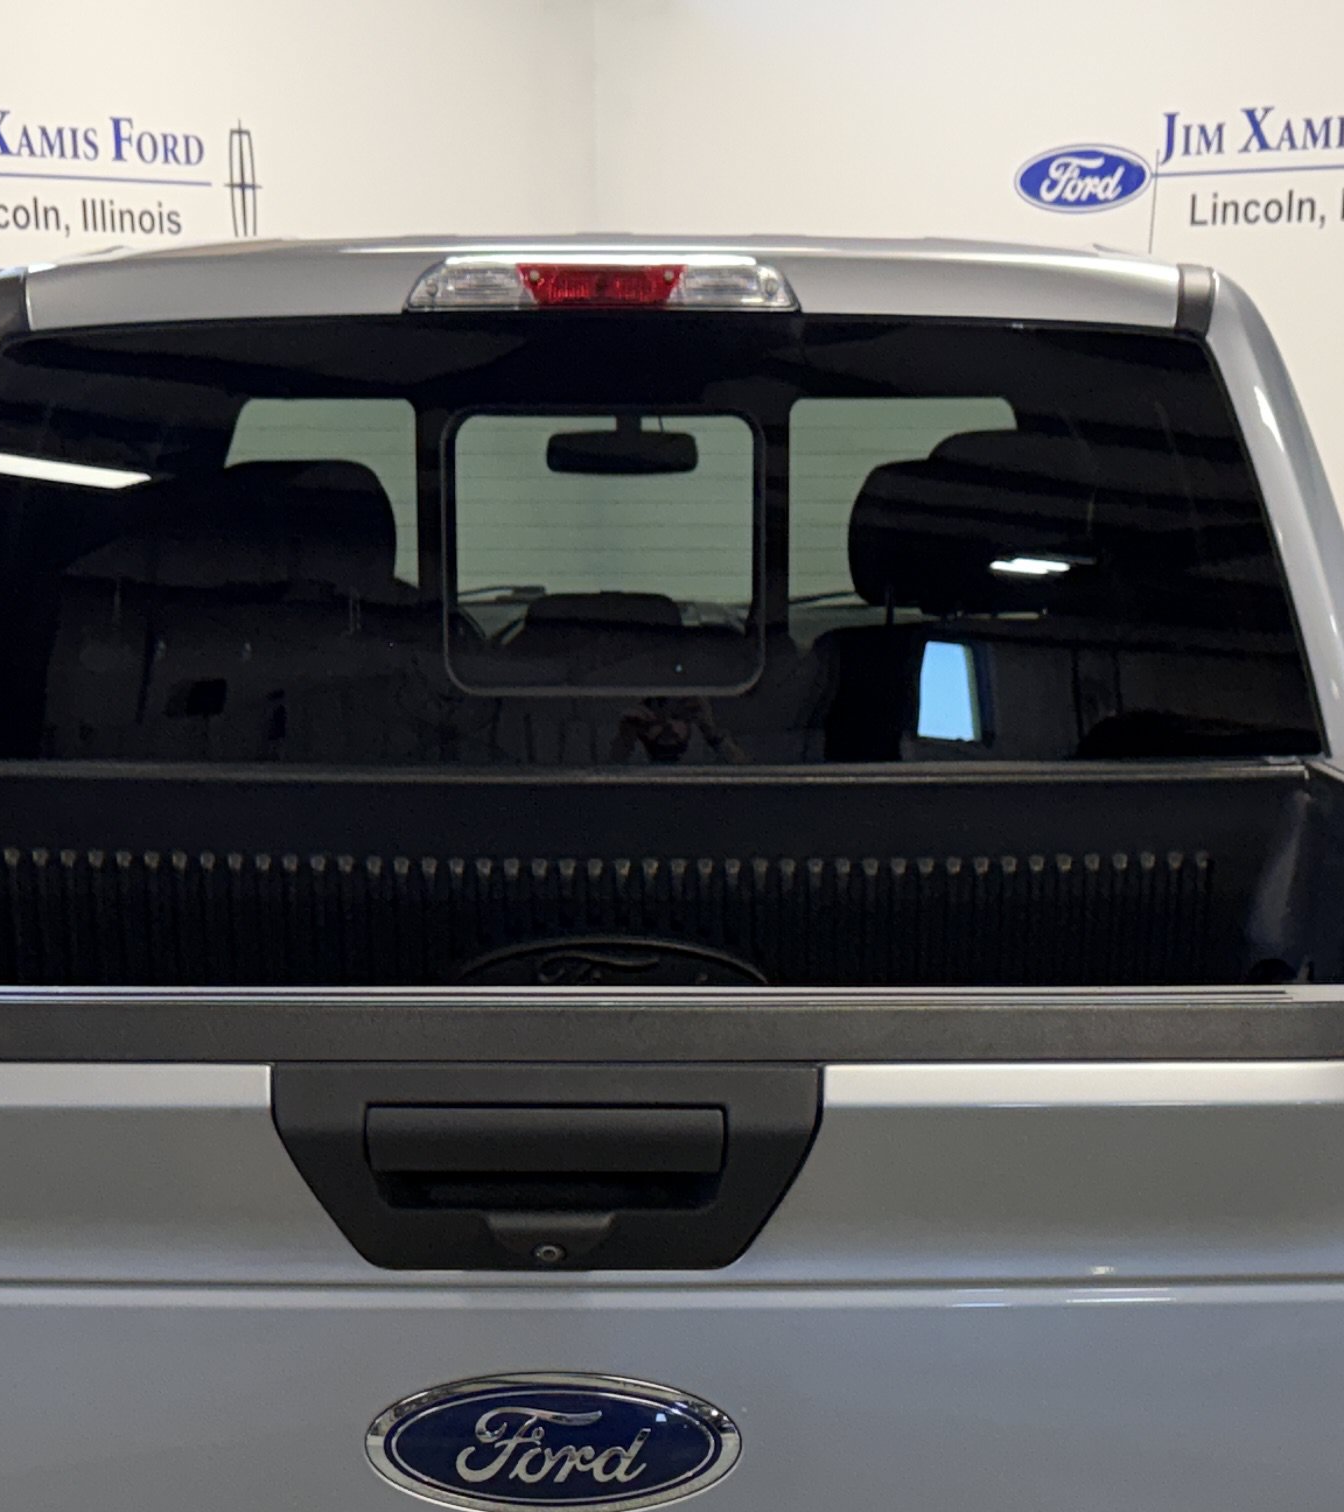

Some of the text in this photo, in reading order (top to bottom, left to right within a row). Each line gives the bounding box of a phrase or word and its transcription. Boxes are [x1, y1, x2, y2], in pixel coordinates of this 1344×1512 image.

[109, 116, 204, 166] FORD
[1160, 111, 1226, 166] JIM
[1039, 156, 1125, 203] Ford
[82, 197, 182, 235] Illinois
[1189, 188, 1327, 229] Lincoln,
[456, 1406, 652, 1483] Ford
